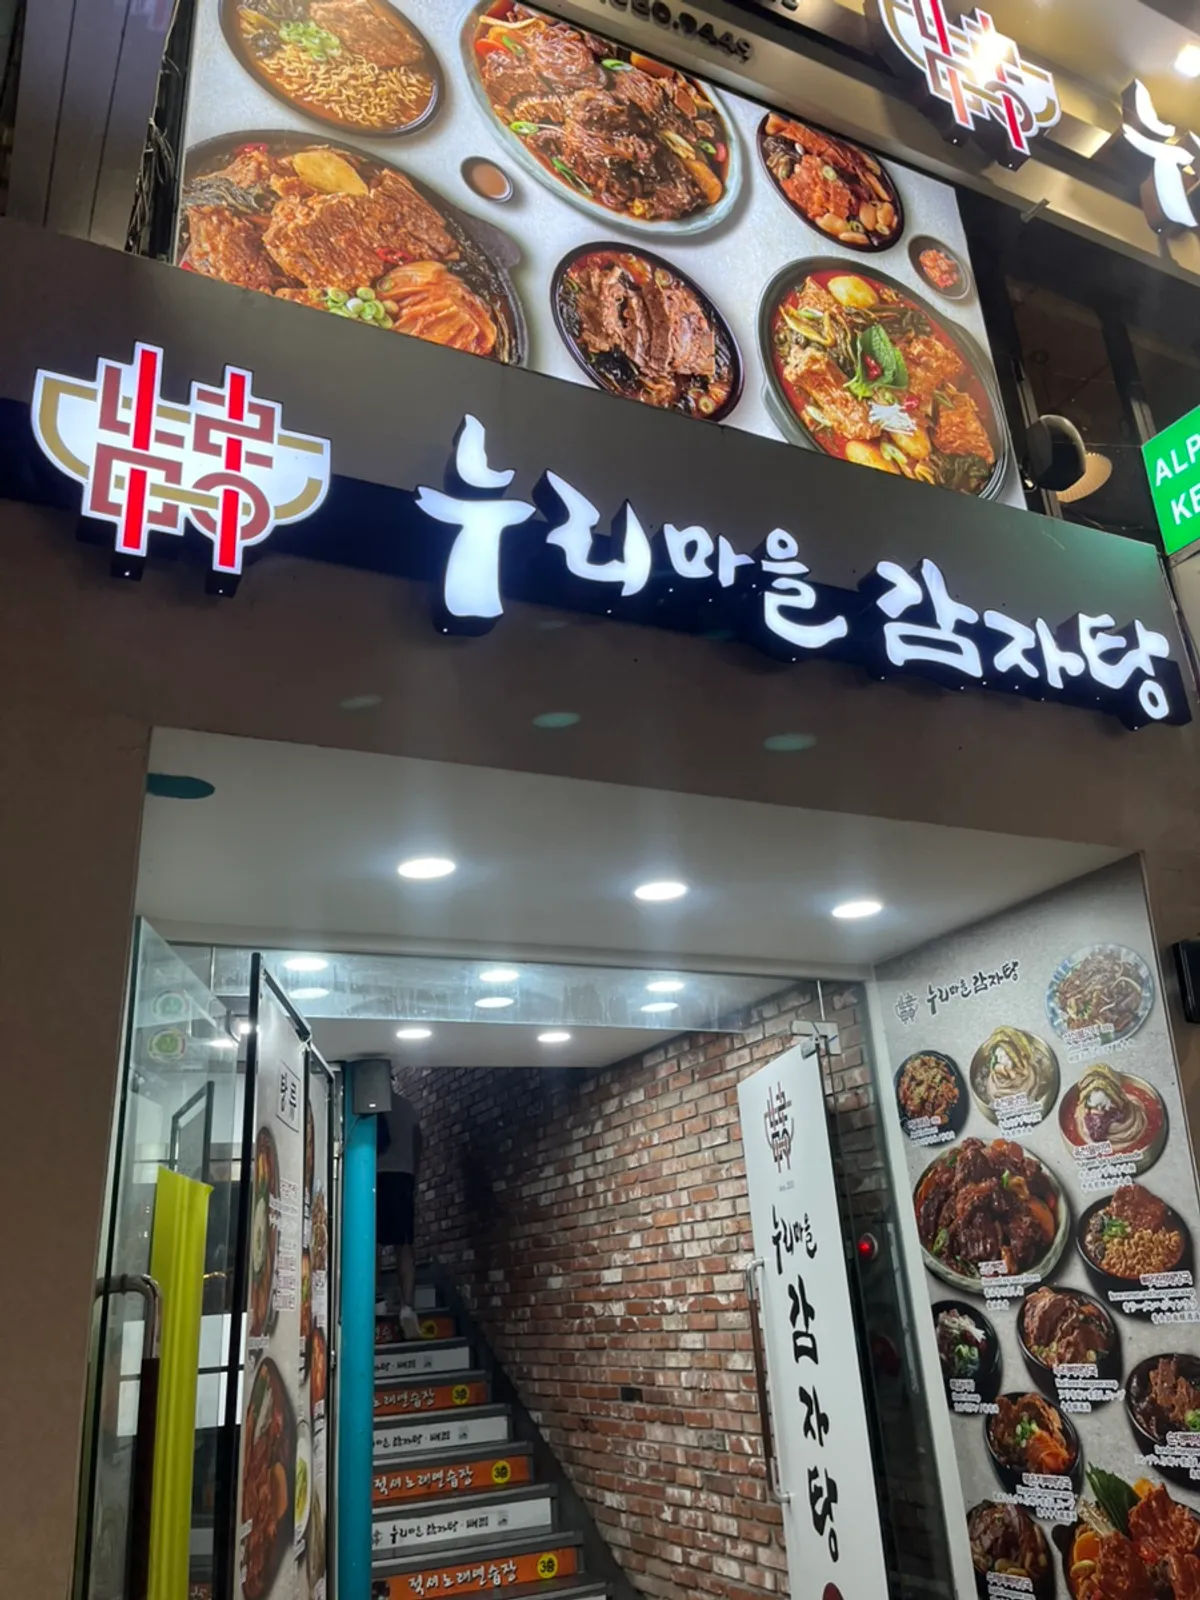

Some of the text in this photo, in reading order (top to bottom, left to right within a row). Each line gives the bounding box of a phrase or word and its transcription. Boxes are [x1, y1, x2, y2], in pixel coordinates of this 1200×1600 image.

[415, 414, 1170, 720] 누리마을 감자탕
[926, 960, 1019, 1016] 누리마을 감자탕
[772, 1204, 817, 1275] 누리마을
[788, 1274, 839, 1563] 감자탕
